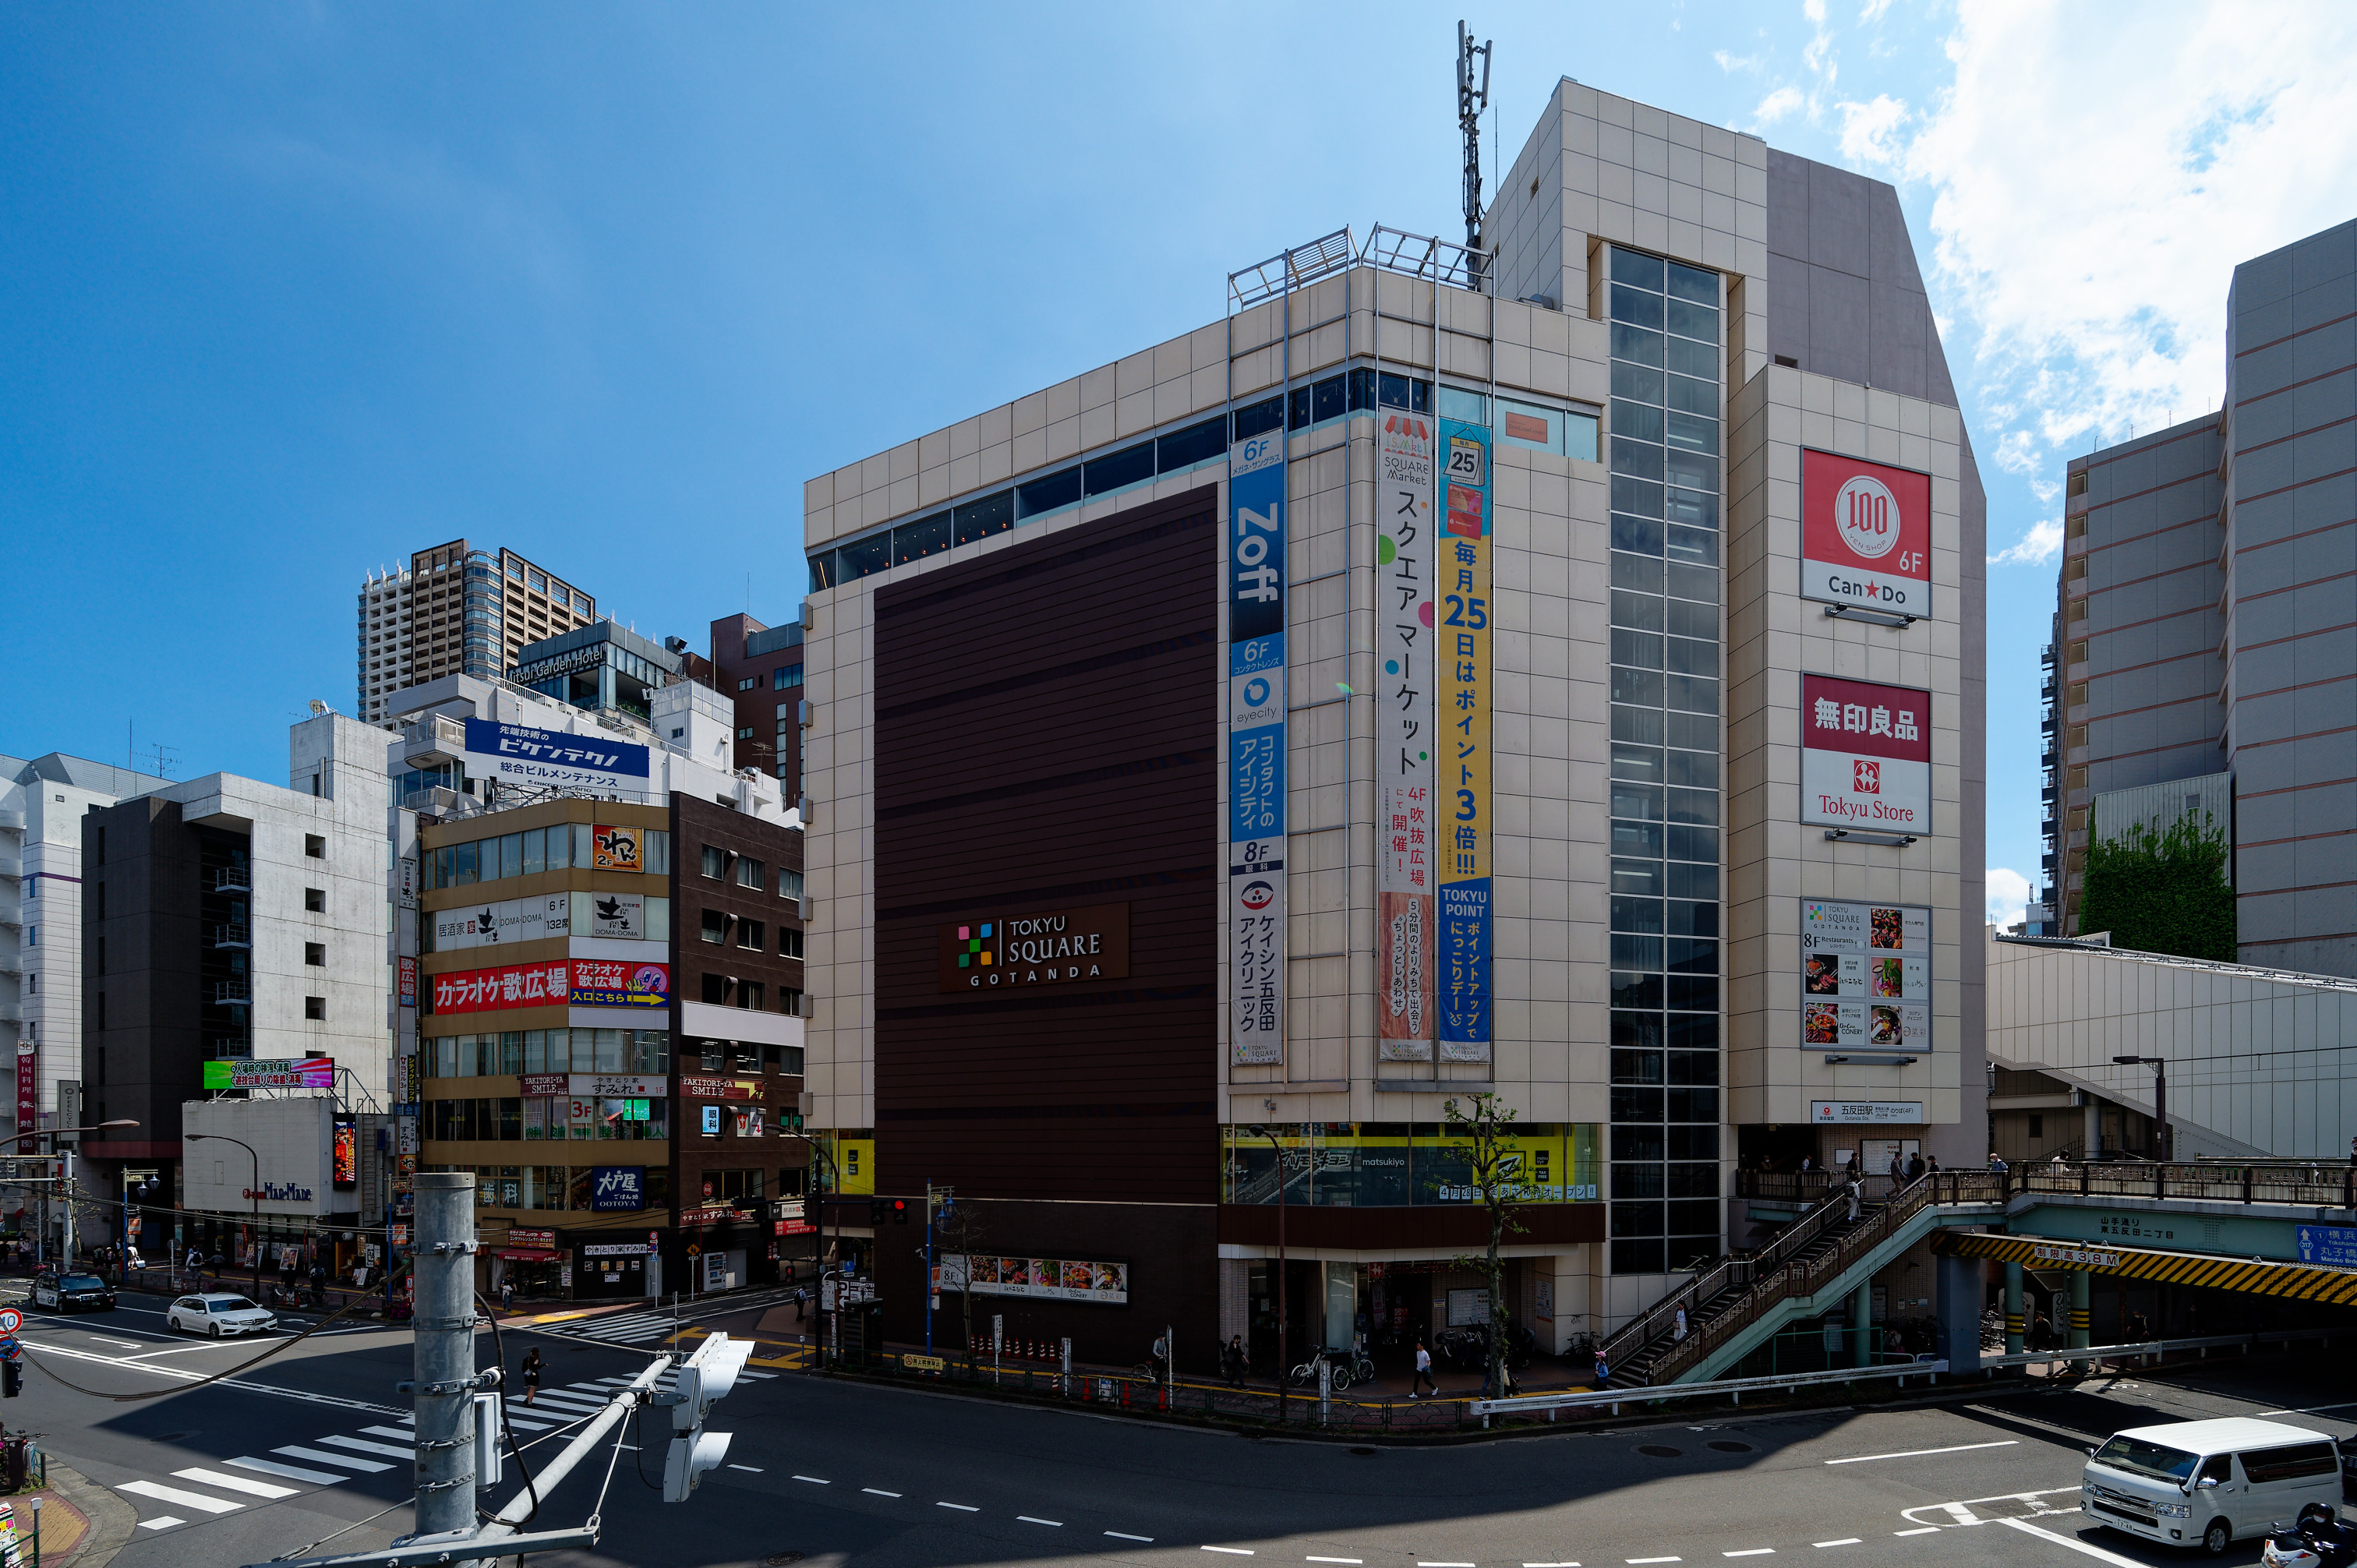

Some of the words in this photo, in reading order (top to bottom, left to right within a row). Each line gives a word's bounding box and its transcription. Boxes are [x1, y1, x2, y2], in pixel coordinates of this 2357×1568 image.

[1243, 439, 1270, 461] 6F
[1232, 454, 1281, 476] メガネ・サングラス
[1451, 451, 1475, 473] 25
[1387, 470, 1427, 486] Market
[1846, 489, 1888, 535] 100
[1849, 533, 1864, 549] YEN
[1865, 539, 1886, 551] SHOP
[1236, 502, 1278, 604] Zoff
[1899, 550, 1923, 573] 6F
[1829, 575, 1863, 597] Can
[1882, 584, 1906, 604] Do
[1395, 490, 1419, 775] スクエアマーケット
[1243, 641, 1270, 662] 6F
[504, 666, 534, 684] Mitsui
[536, 658, 572, 677] Garden
[575, 645, 603, 666] Hotel
[1233, 657, 1280, 675] コンタクトレンズ
[1236, 705, 1277, 723] eyecity
[1814, 696, 1918, 741] 無印良品
[499, 724, 549, 741] 先端技術の
[498, 737, 620, 768] ビケンテクノ
[500, 761, 618, 787] 総合ビルメンテナンス
[1239, 739, 1256, 828] アイシティ
[1260, 735, 1274, 827] コンタクトの
[1818, 794, 1868, 821] Tokyu
[1872, 800, 1914, 822] Store
[1408, 786, 1426, 887] 4F吹抜広場
[597, 855, 613, 866] 2F
[1244, 840, 1269, 863] 8F
[1245, 863, 1269, 874] 眼科
[1442, 888, 1487, 903] TOKYU
[1444, 902, 1485, 917] POINT
[1828, 913, 1861, 923] SQUARE
[437, 921, 466, 938] 居酒家
[546, 917, 569, 931] 132席
[1009, 915, 1065, 937] TOKYU
[1813, 923, 1861, 931] GOTANDA
[1009, 933, 1101, 965] SQUARE
[1804, 933, 1822, 948] 8F
[575, 962, 625, 976] カラオケ
[970, 964, 1101, 987] GOTANDA
[1239, 916, 1256, 1033] アイクリニック
[1259, 914, 1275, 1032] ケイシン五反田
[1408, 900, 1419, 1031] 5分間のよりみちで出会う
[1450, 920, 1463, 1011] にっこりデー
[401, 957, 415, 995] 歌広場
[578, 974, 623, 989] 歌広場
[1466, 920, 1481, 1039] ポイントアップで
[436, 966, 568, 1008] カラオケ歌広場
[571, 991, 625, 1003] 入口こちら
[401, 994, 415, 1005] 5F
[1251, 1049, 1277, 1058] SQUARE
[20, 1055, 32, 1094] 韓国料理
[408, 1057, 416, 1103] シティクリニック
[525, 1076, 564, 1085] YAKITORI-YA
[683, 1077, 733, 1088] YAKITORI-YA
[532, 1084, 557, 1094] SMILE
[592, 1083, 635, 1096] すみれ
[691, 1086, 725, 1097] SMILE
[571, 1100, 592, 1118] 3F
[708, 1109, 718, 1129] 眼科
[1841, 1105, 1874, 1115] 五反田駅
[1362, 1157, 1405, 1167] matsukiyo
[596, 1169, 639, 1196] 大戸屋
[482, 1182, 518, 1205] 歯科
[709, 1209, 735, 1220] すみれ
[2101, 1217, 2140, 1226] 山手通り
[2101, 1225, 2175, 1240] 東五反田二丁目
[2328, 1230, 2355, 1241] 横浜
[2037, 1246, 2117, 1267] 制限高3.8M
[2320, 1246, 2357, 1259] 丸子橋
[943, 1270, 956, 1280] 8F
